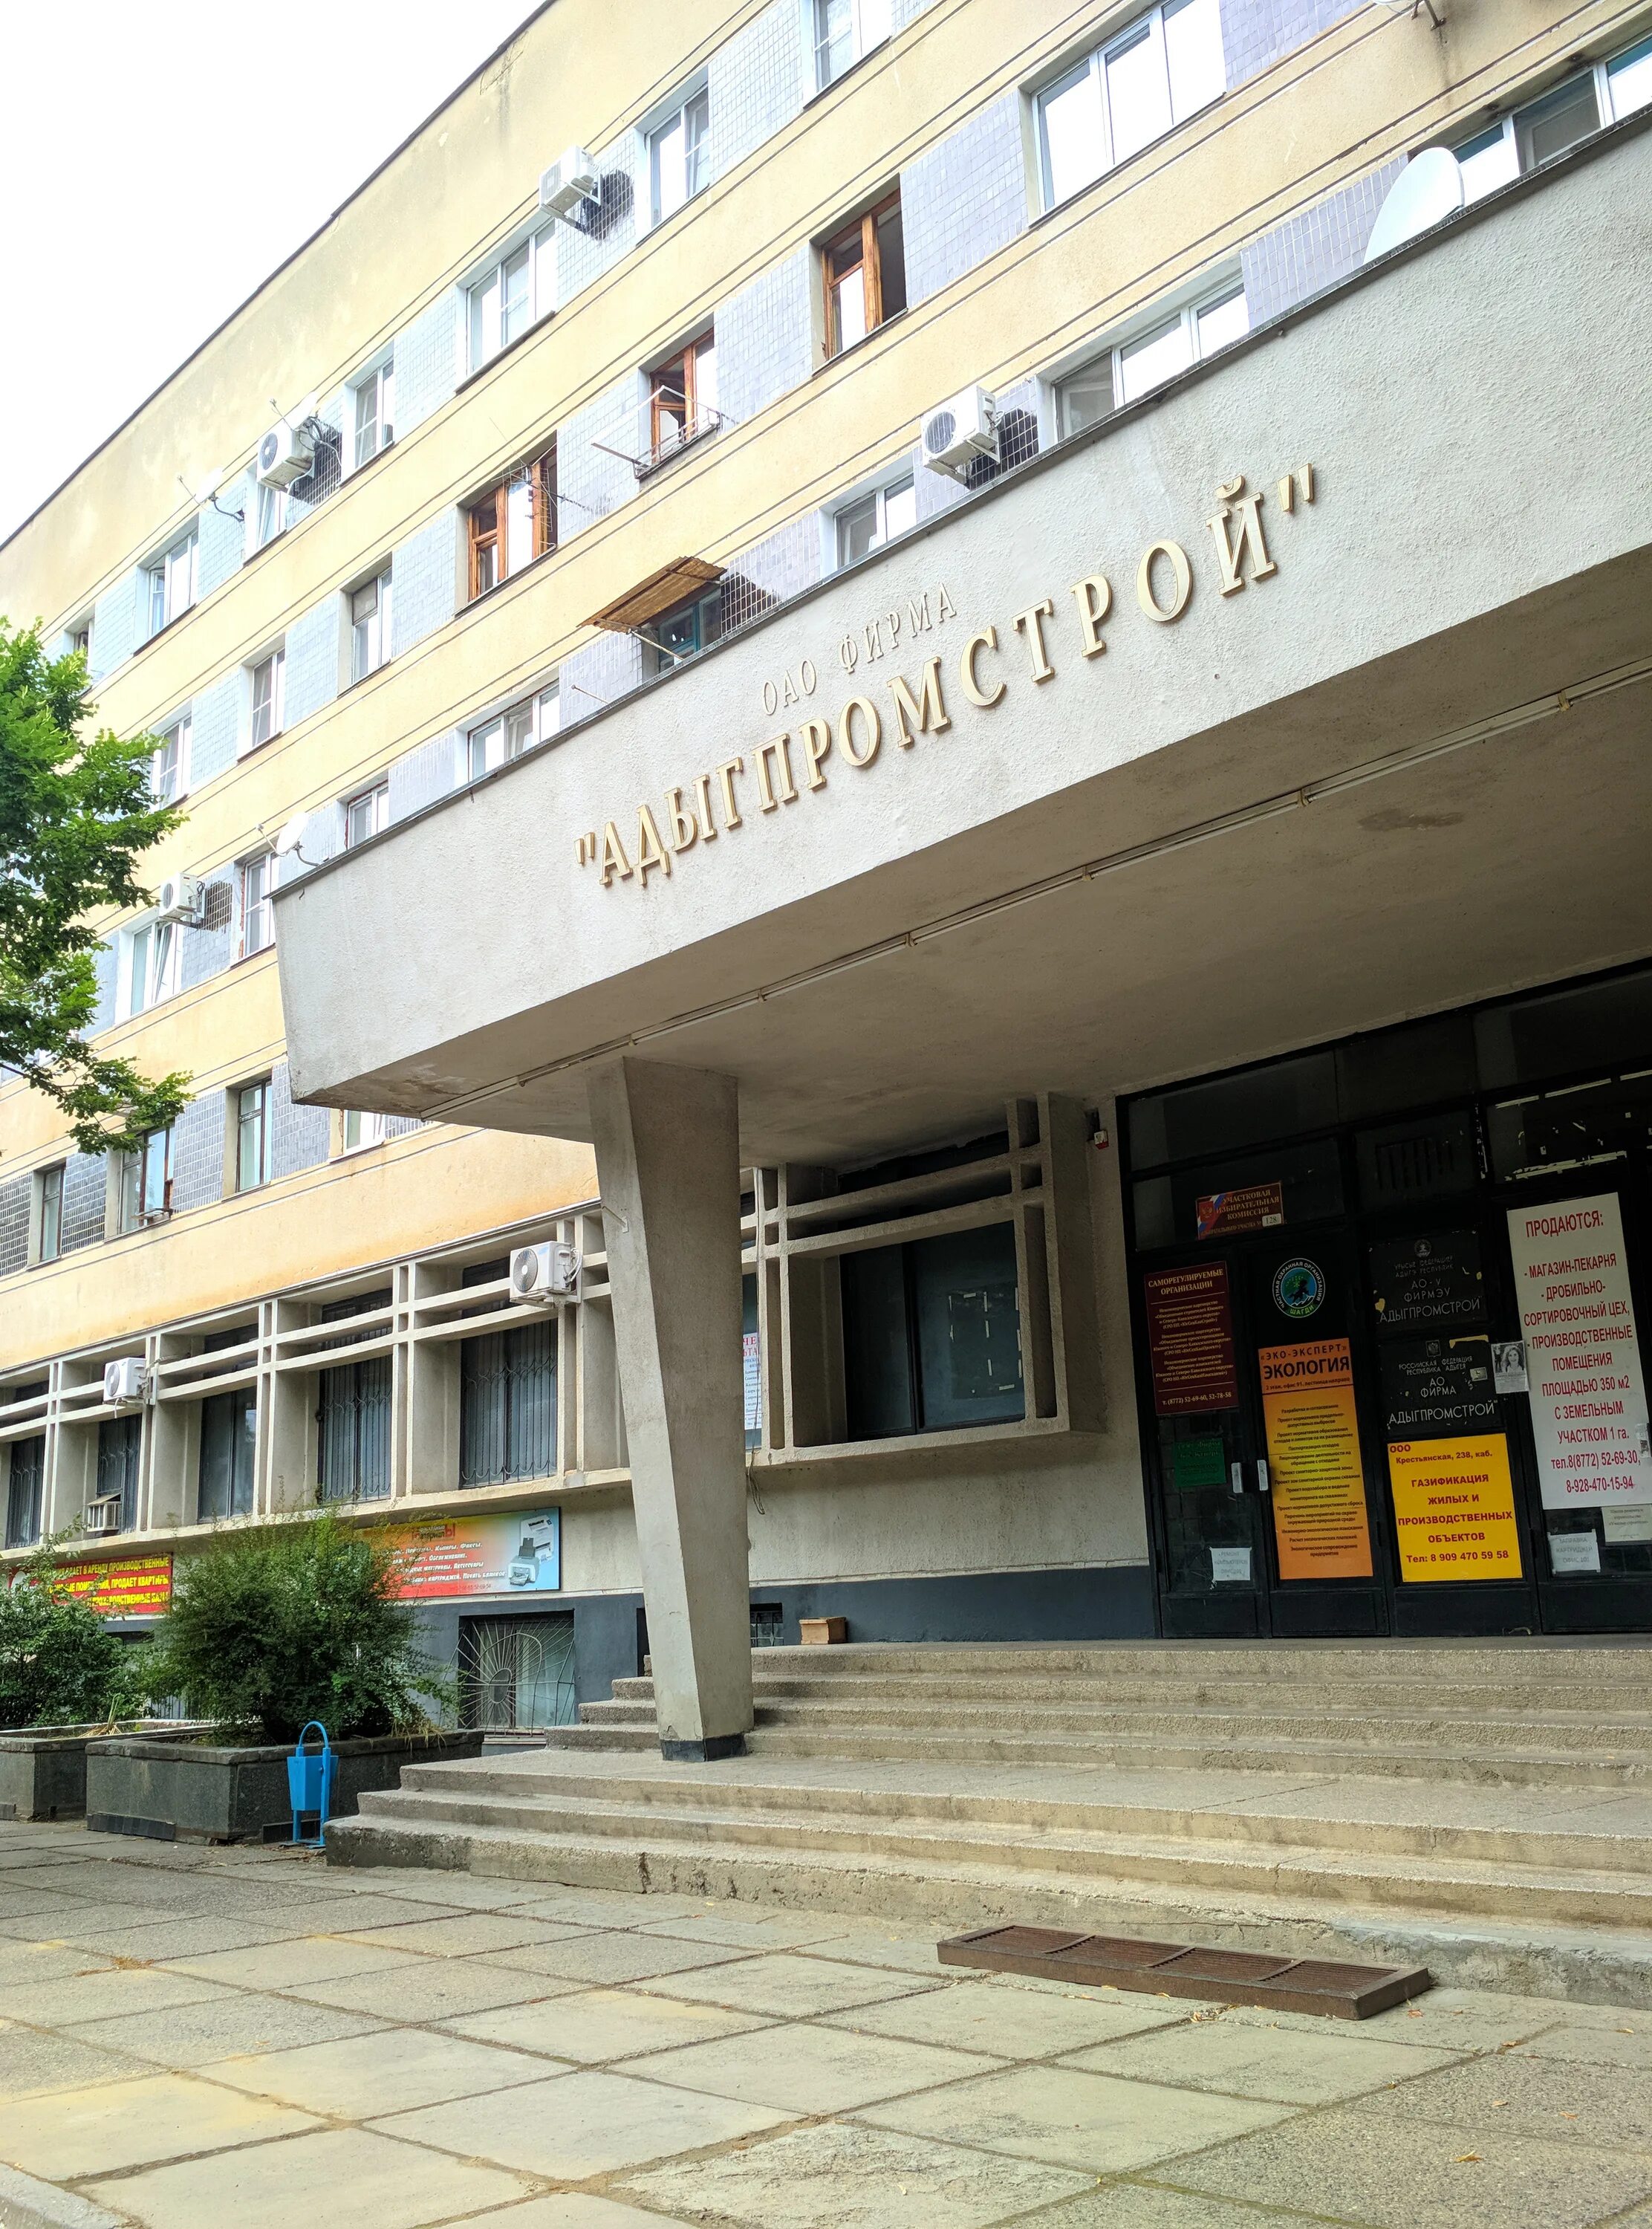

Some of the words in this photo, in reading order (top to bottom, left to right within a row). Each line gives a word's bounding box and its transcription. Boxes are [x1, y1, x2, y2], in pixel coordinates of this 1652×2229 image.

[762, 658, 817, 716] ОАО
[838, 582, 956, 675] ФИРМА
[574, 464, 1313, 886] "АДЫГПРОМСТРОЙ"
[1217, 1195, 1279, 1213] ИЗБИРАТЕЛЬНАЯ
[1223, 1189, 1271, 1204] УЧАСТКОВАЯ
[1227, 1207, 1269, 1220] КОМИССИЯ
[1526, 1210, 1604, 1237] ПРОДАЮТСЯ:
[1278, 1262, 1304, 1279] ОХРАННАЯ
[1529, 1253, 1616, 1278] МАГАЗИН-ПЕКАРНЯ
[1148, 1268, 1224, 1288] САМОРЕГУЛИРУЕМЫЕ
[1304, 1263, 1324, 1302] ОРГАНИЗАЦИЯ
[1161, 1280, 1213, 1295] ОРГАНИЗАЦИИ
[1275, 1280, 1285, 1308] ЧАСТНАЯ
[1404, 1287, 1451, 1302] ФИРМЭУ
[1547, 1279, 1606, 1302] ДРОБИЛЬНО-
[1290, 1305, 1315, 1314] ШАГДИ
[1524, 1301, 1605, 1326] СОРТИРОВОЧНЫЙ
[1608, 1300, 1630, 1318] ЦЕХ,
[1532, 1325, 1633, 1349] ПРОИЗВОДСТВЕННЫЕ
[1264, 1356, 1350, 1380] ЭКОЛОГИЯ
[1399, 1360, 1437, 1370] РОССИЙСКАЯ
[1442, 1355, 1473, 1366] ФЕДЕРАЦИЯ
[1552, 1352, 1612, 1372] ПОМЕЩЕНИЯ
[1406, 1366, 1441, 1376] РЕСПУБЛИКА
[1430, 1376, 1445, 1387] АО
[1542, 1378, 1597, 1397] ПЛОЩАДЬЮ
[1600, 1377, 1616, 1391] 350
[1618, 1375, 1630, 1389] м2
[1420, 1386, 1457, 1398] ФИРМА
[1168, 1398, 1183, 1406] (8772)
[1555, 1406, 1561, 1420] С
[1564, 1401, 1624, 1419] ЗЕМЕЛЬНЫМ
[1558, 1427, 1607, 1444] УЧАСТКОМ
[1610, 1427, 1615, 1440] 1
[1617, 1428, 1629, 1439] га.
[1390, 1444, 1411, 1453] ООО
[1396, 1453, 1454, 1464] Крестьянская,
[1456, 1452, 1473, 1460] 238,
[1601, 1450, 1641, 1467] 52-69-30,
[1411, 1474, 1489, 1487] ГАЗИФИКАЦИЯ
[1566, 1476, 1633, 1493] 8-928-470-15-94
[1428, 1495, 1469, 1505] ЖИЛЫХ
[1398, 1511, 1512, 1526] ПРОИЗВОДСТВЕННЫХ
[1428, 1532, 1485, 1542] ОБЪЕКТОВ
[1406, 1554, 1427, 1563] Тел:
[1440, 1553, 1457, 1561] 909
[1460, 1551, 1477, 1560] 470
[1496, 1550, 1509, 1558] 58
[88, 1563, 108, 1574] АРЕНДУ
[109, 1557, 169, 1573] ПРОИЗВОДСТВЕННЫЕ
[111, 1577, 137, 1589] ПРОДАЕТ
